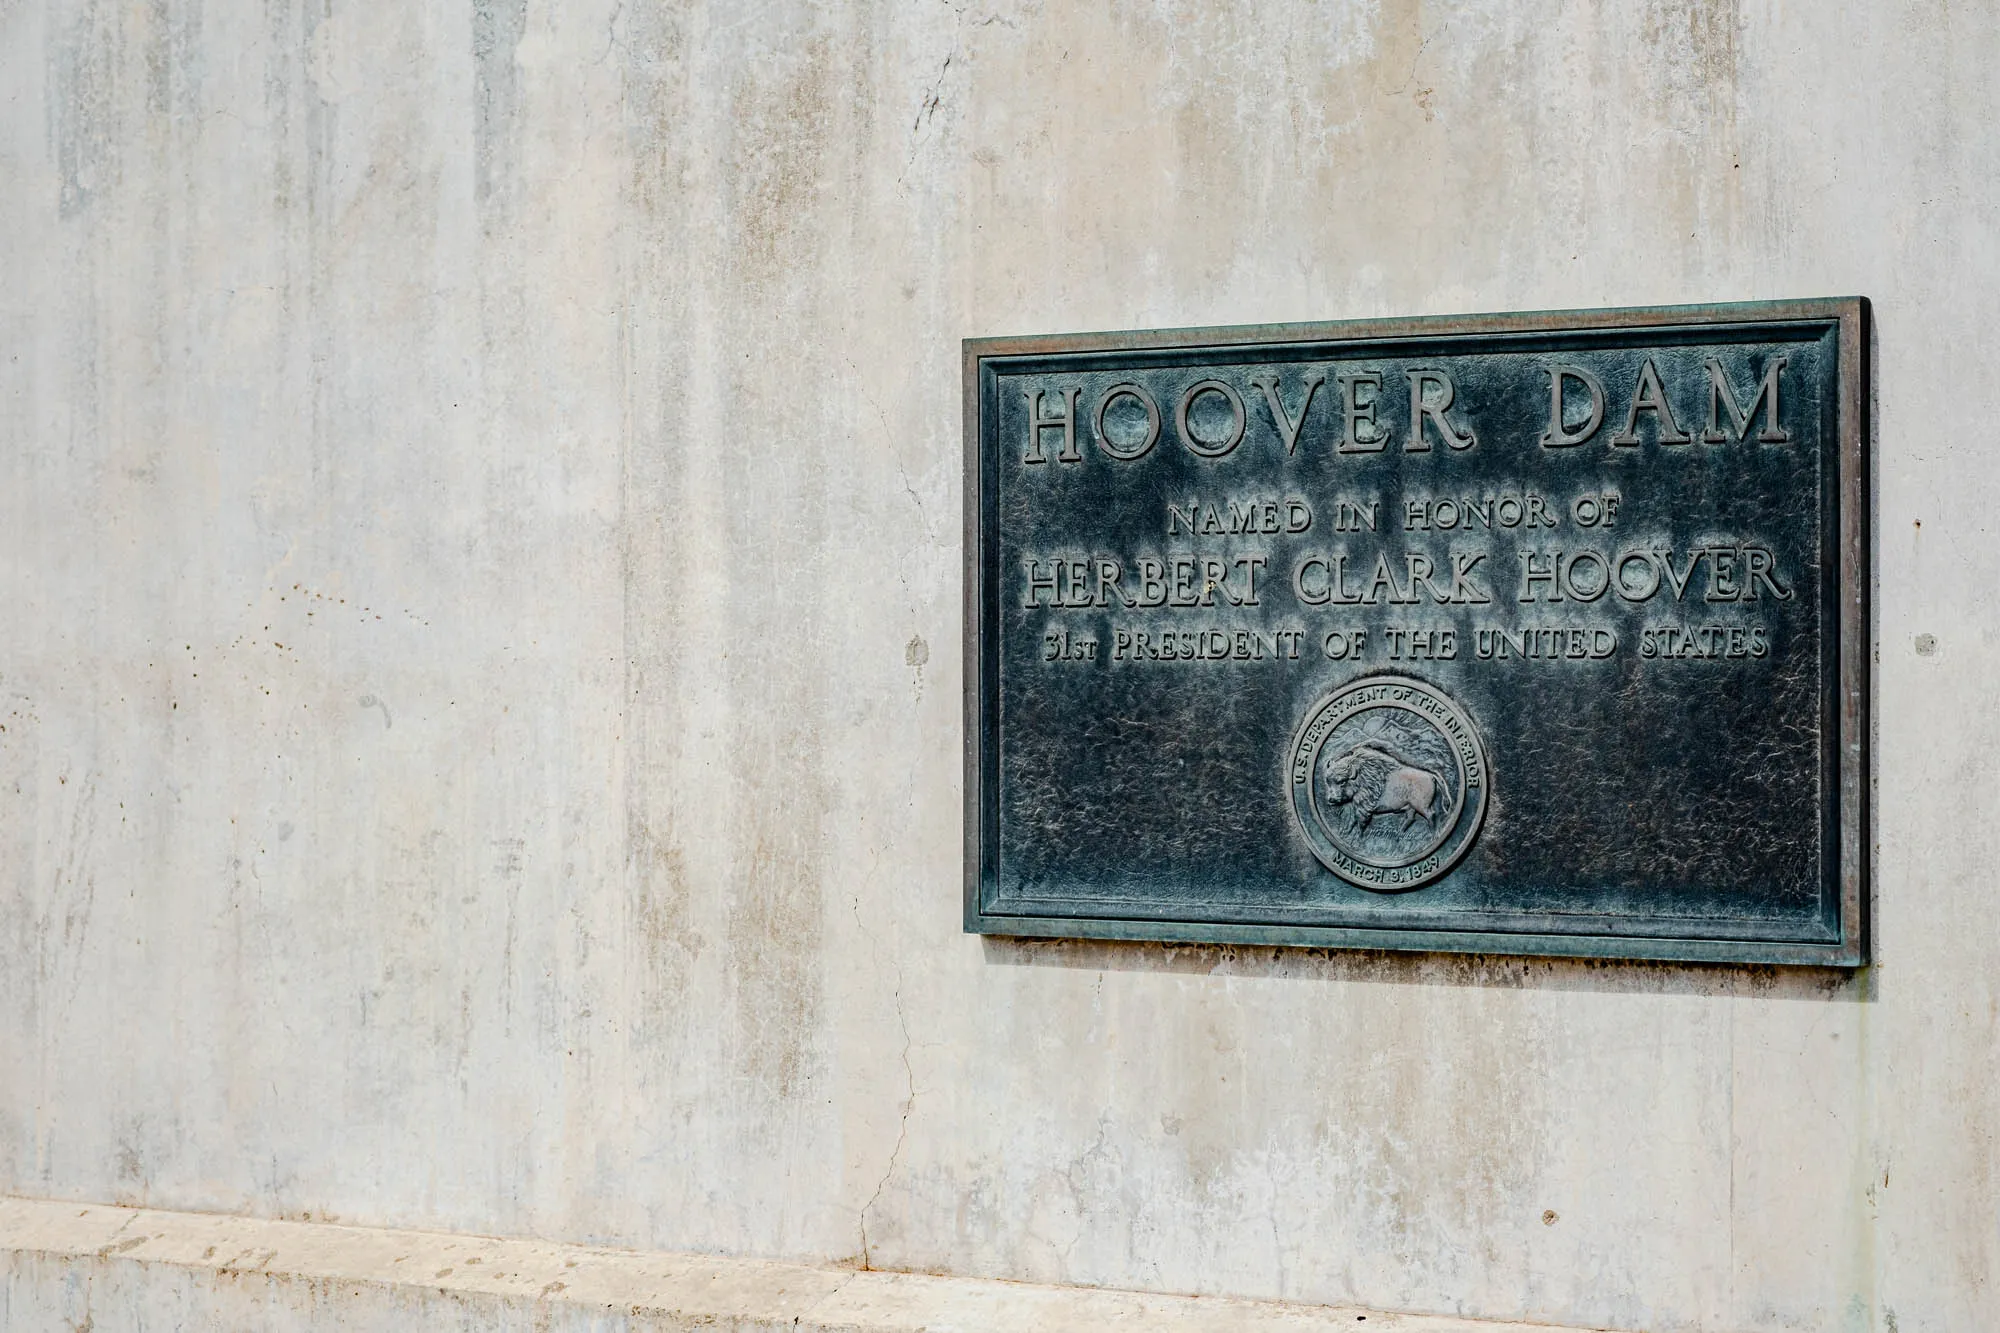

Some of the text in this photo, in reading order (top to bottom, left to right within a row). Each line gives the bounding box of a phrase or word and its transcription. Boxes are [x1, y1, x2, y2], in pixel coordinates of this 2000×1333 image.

[1024, 357, 1788, 464] HOOVER DAM
[1168, 494, 1620, 536] NAMED IN HONOR OF
[1024, 546, 1792, 609] HERBERT CLARK HOOVER
[1113, 629, 1304, 661] PRESIDENT
[1324, 630, 1366, 661] OF
[1385, 629, 1457, 660] THE
[1474, 626, 1617, 660] UNITED
[1641, 624, 1769, 659] STATES
[1294, 687, 1480, 789] U.S. DEPARTMENT OF THE INTERIOR
[1331, 850, 1386, 883] MARCH
[1406, 855, 1441, 882] 1849
